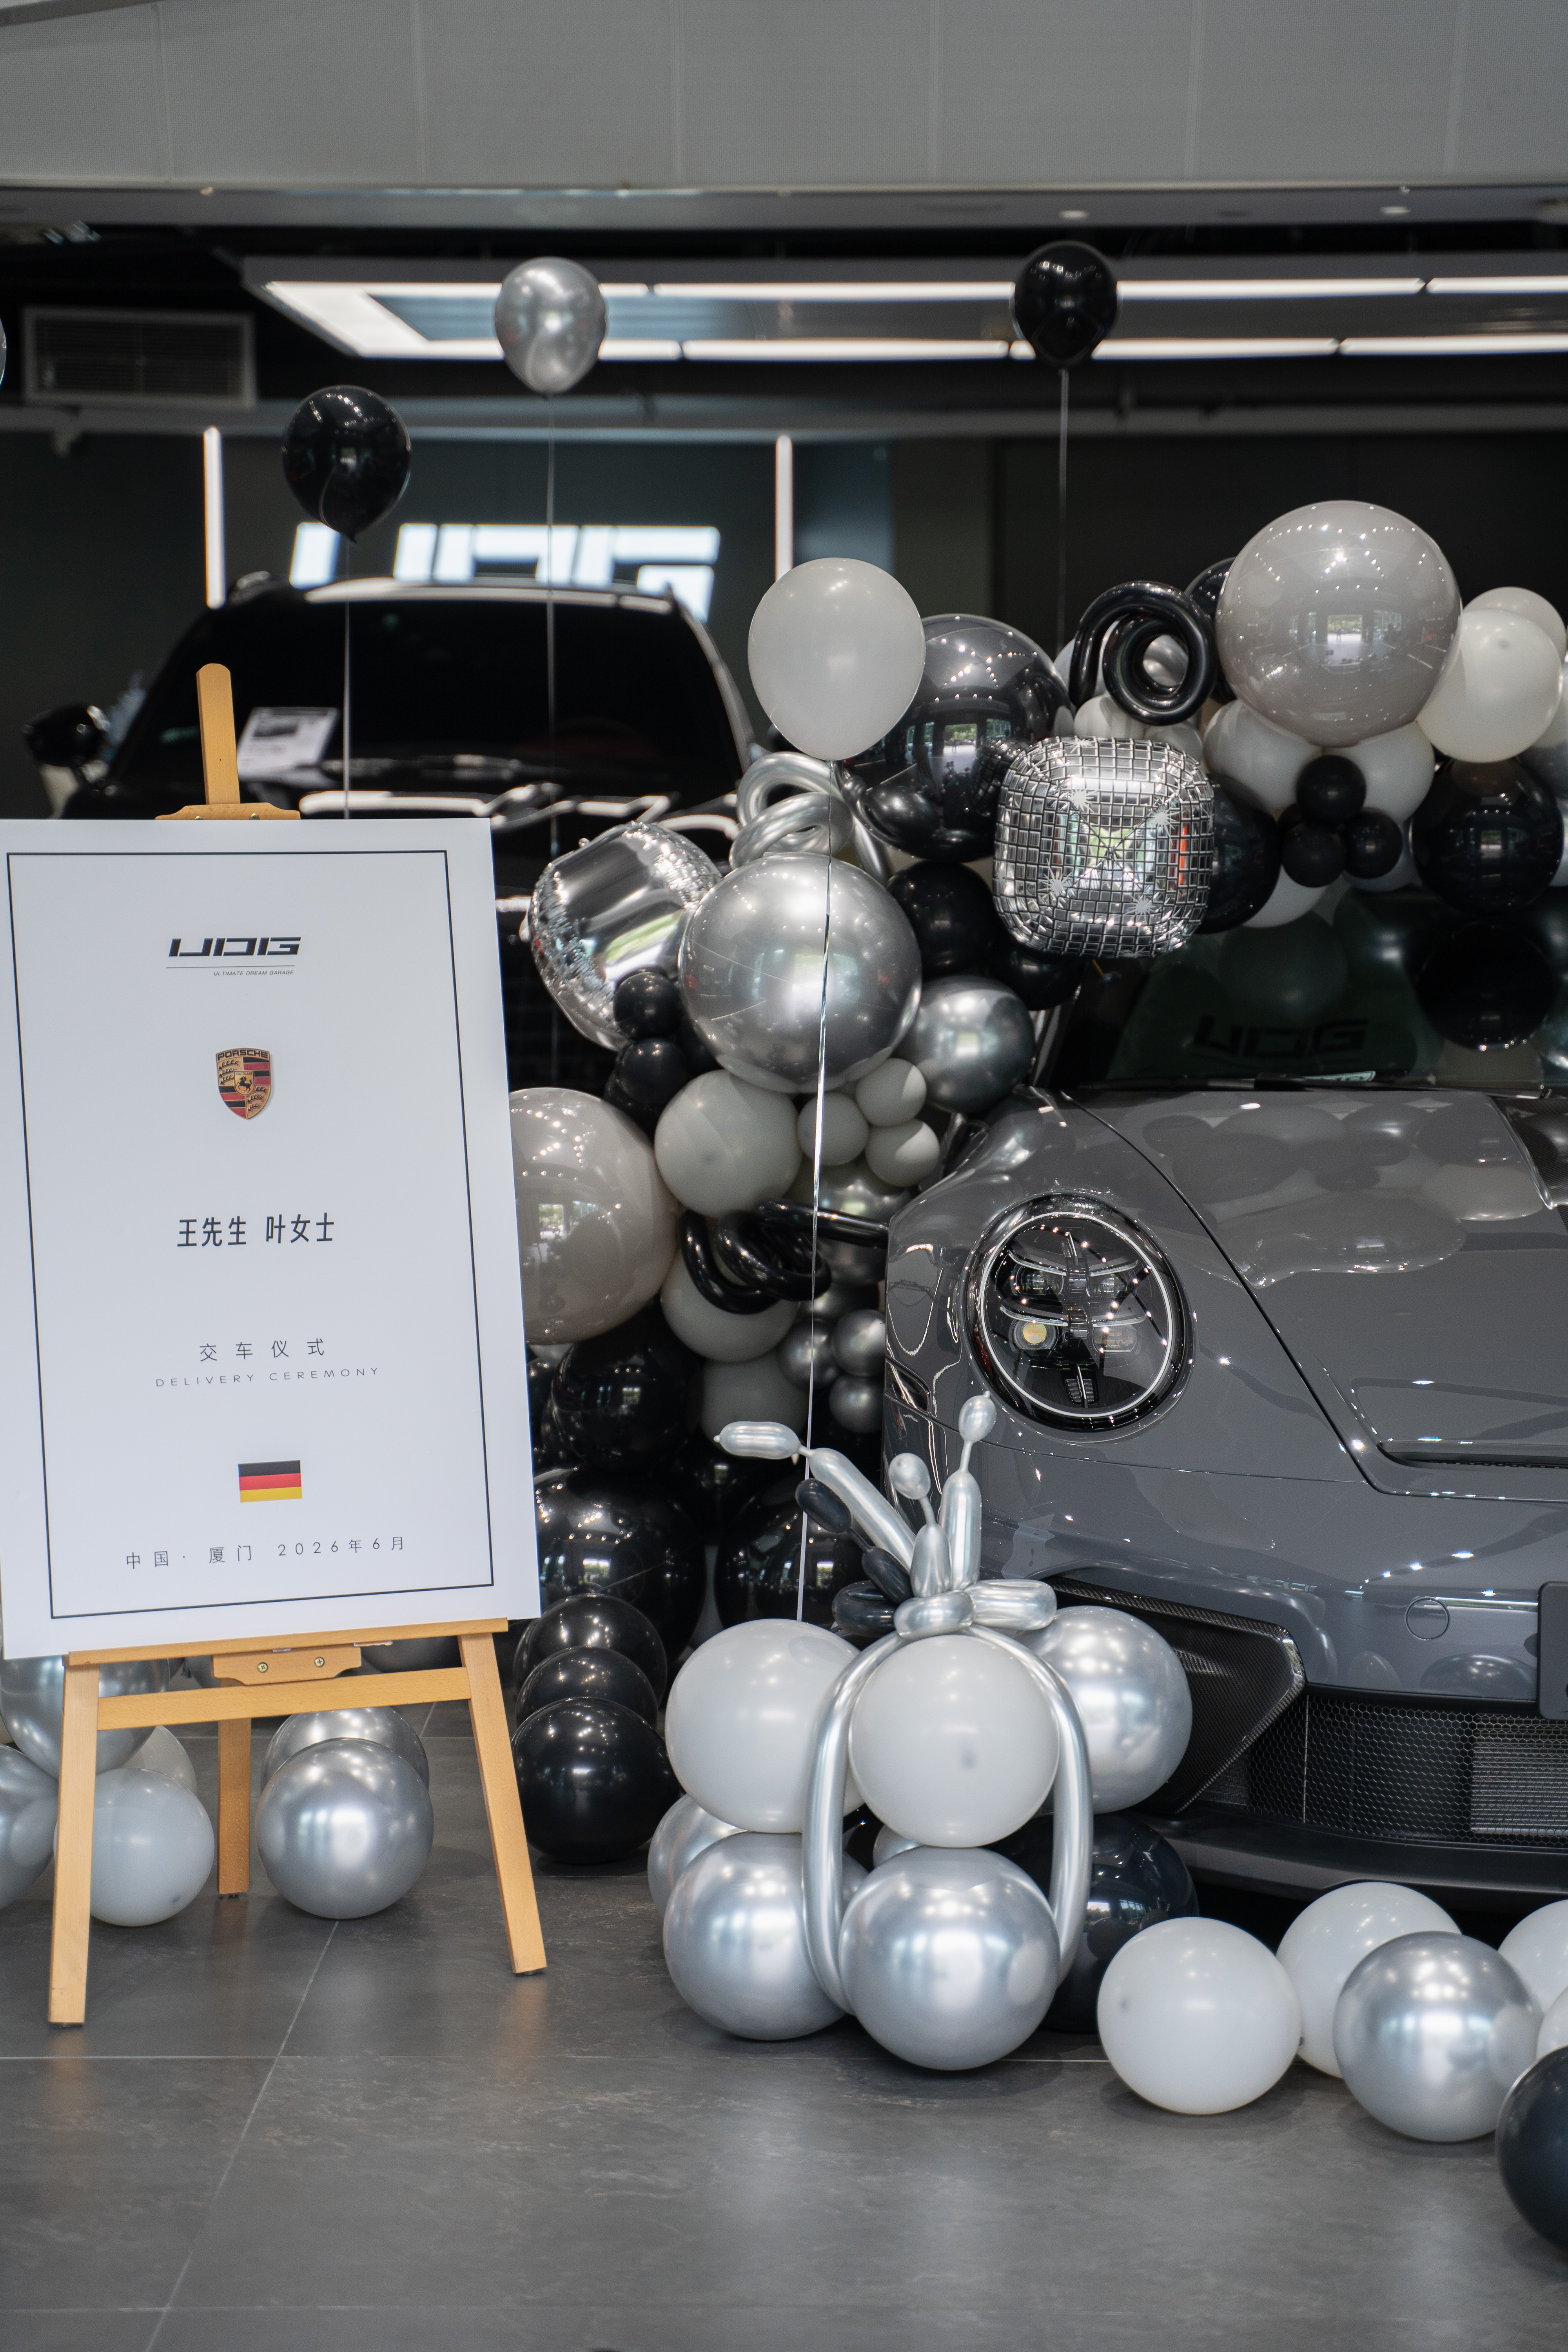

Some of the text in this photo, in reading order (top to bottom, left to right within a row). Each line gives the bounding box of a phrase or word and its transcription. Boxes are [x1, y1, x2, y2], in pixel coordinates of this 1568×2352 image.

[169, 937, 301, 957] UDG
[217, 1049, 269, 1061] PORSCHE
[177, 1212, 334, 1247] 王先生 叶女士
[200, 1338, 325, 1362] 交车仪式
[156, 1368, 377, 1387] DELIVERY CEREMONY
